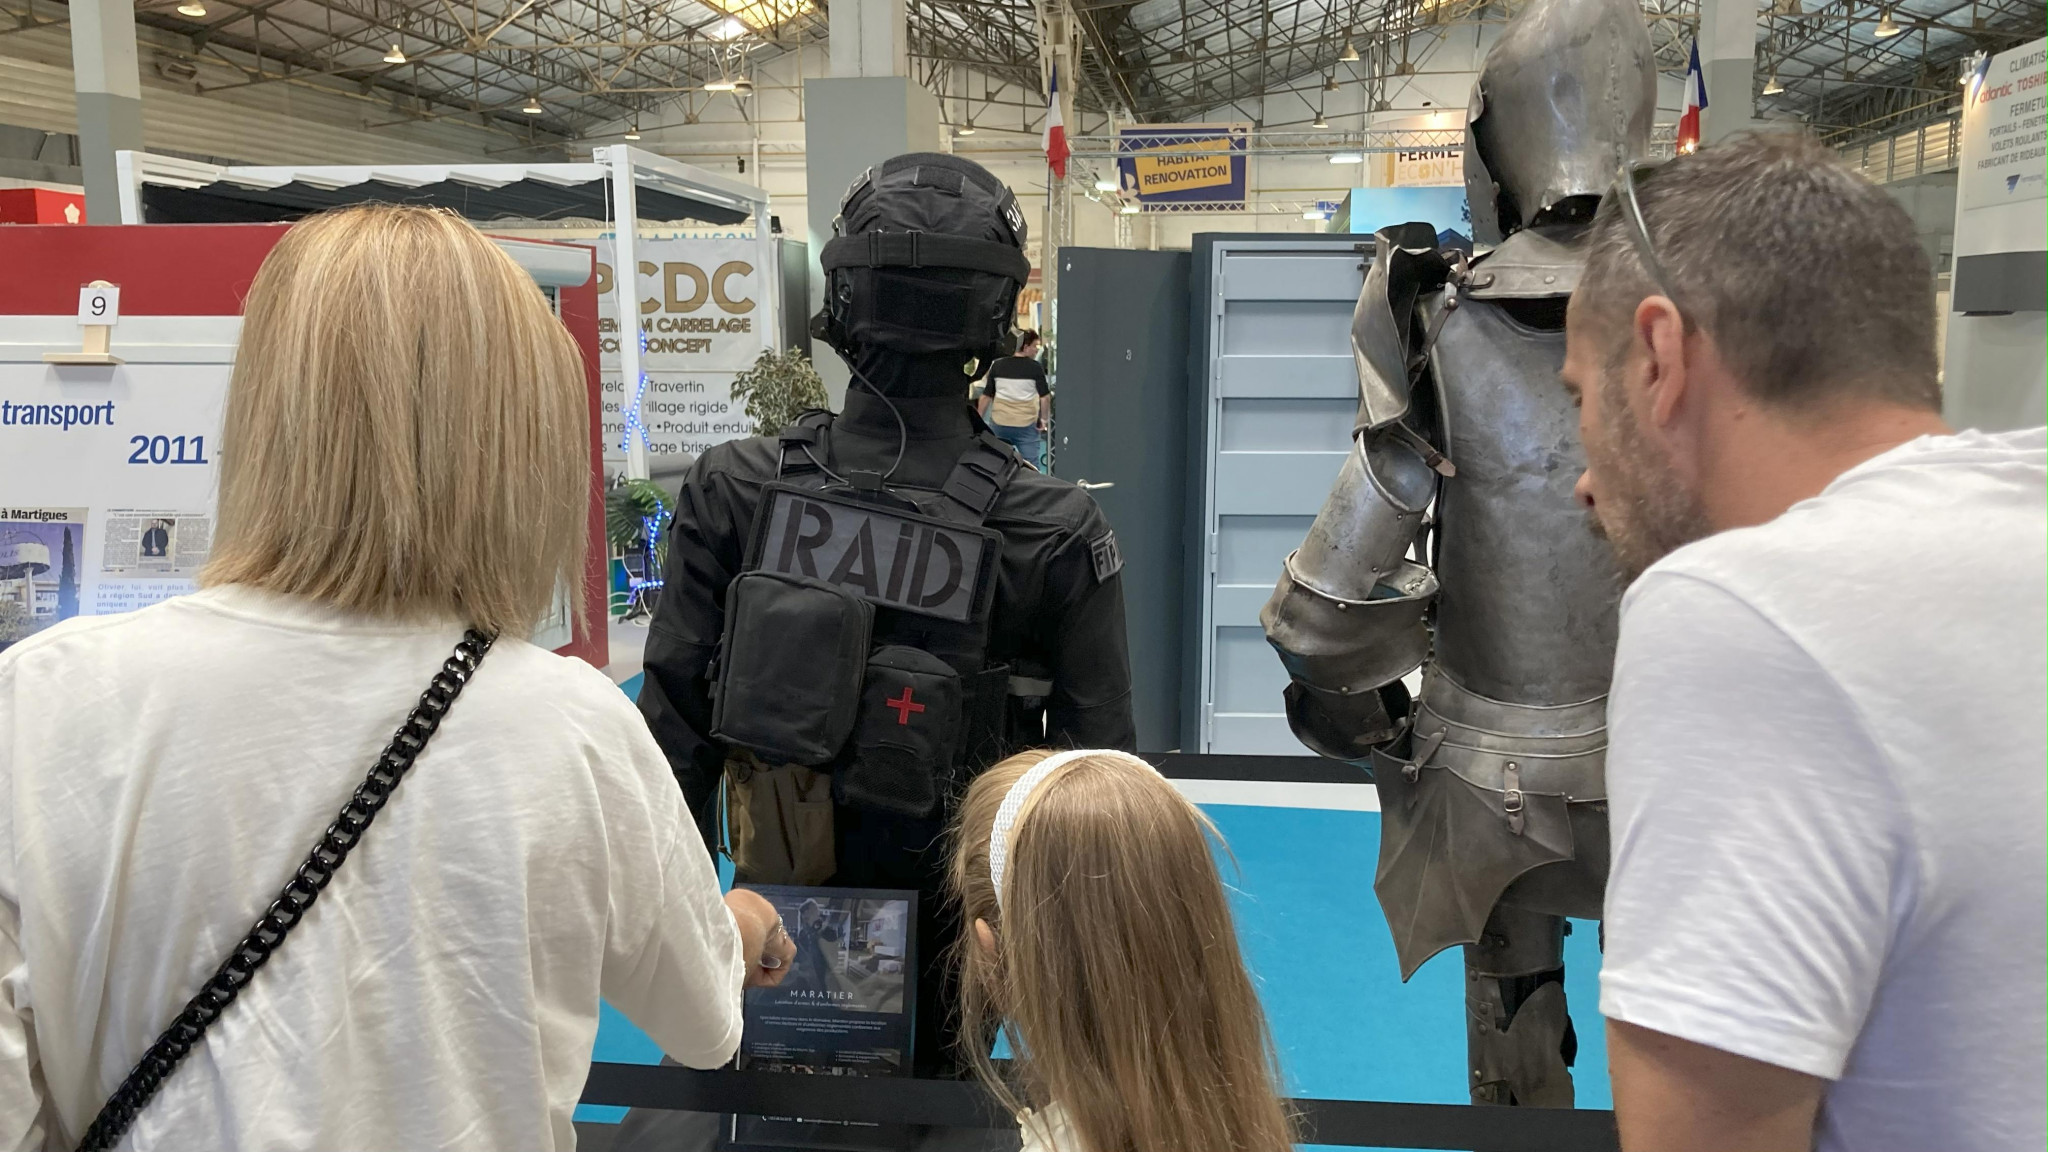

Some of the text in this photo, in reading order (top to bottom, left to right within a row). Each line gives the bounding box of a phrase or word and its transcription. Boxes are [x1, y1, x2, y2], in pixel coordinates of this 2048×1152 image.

[2010, 50, 2048, 73] CLIMATIS
[1980, 81, 2013, 103] atlantic
[1989, 122, 2017, 137] PORTAILS
[1399, 143, 1464, 162] FERME
[1992, 138, 2013, 152] VOLETS
[1978, 146, 2046, 170] FABRICANT DE RIDEAUX
[1144, 165, 1227, 185] RENOVATION
[91, 296, 107, 316] 9
[657, 318, 751, 333] CARRELAGE
[644, 338, 712, 353] ONCEPT
[649, 381, 704, 392] Travertin
[2, 400, 115, 431] transport
[690, 402, 728, 416] rigide
[664, 421, 709, 433] Produit
[128, 435, 208, 464] 2011
[1, 508, 68, 522] à Martigues
[790, 989, 854, 1000] MARATIER
